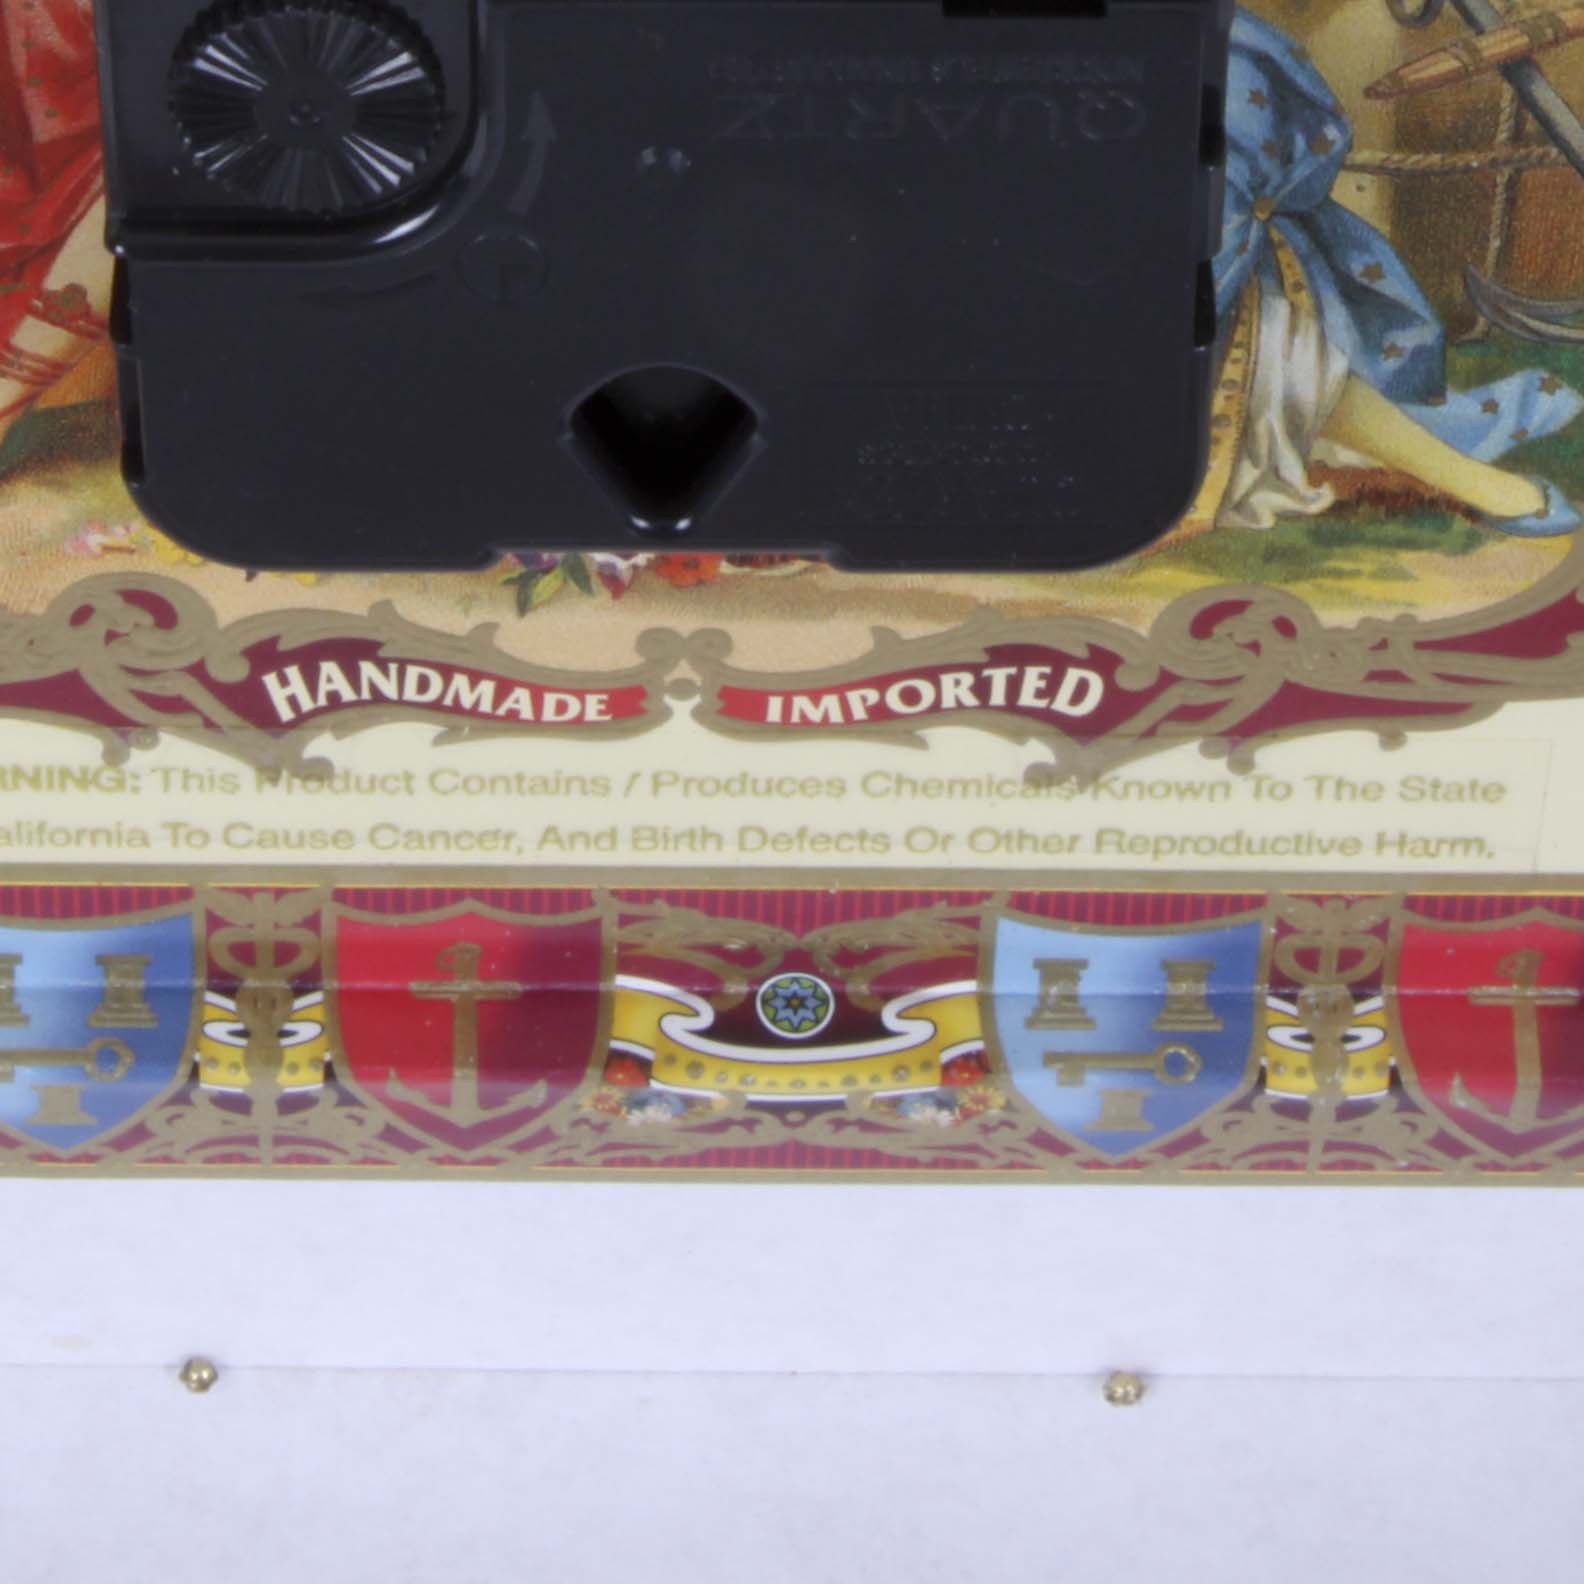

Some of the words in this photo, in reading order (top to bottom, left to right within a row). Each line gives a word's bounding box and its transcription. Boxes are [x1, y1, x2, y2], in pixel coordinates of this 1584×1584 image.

[710, 88, 1148, 143] QUARTZ
[262, 660, 613, 723] HANDMADE
[765, 665, 1105, 724] IMPORTED
[153, 766, 240, 796] This
[255, 766, 416, 797] Product
[428, 767, 611, 798] Contains
[650, 770, 846, 799] Produces
[860, 770, 1077, 801] Chemicals
[1091, 773, 1231, 802] Known
[1248, 773, 1293, 802] To
[1304, 773, 1384, 803] The
[1398, 774, 1506, 803] State
[160, 821, 209, 850] To
[223, 822, 355, 851] Cause
[368, 823, 524, 856] Cancer,
[537, 824, 617, 853] And
[632, 824, 724, 854] Birth
[737, 824, 891, 855] Defects
[904, 826, 955, 854] Or
[968, 827, 1080, 856] Other
[1094, 827, 1361, 860] Reproductive
[1376, 830, 1495, 859] Harm.
